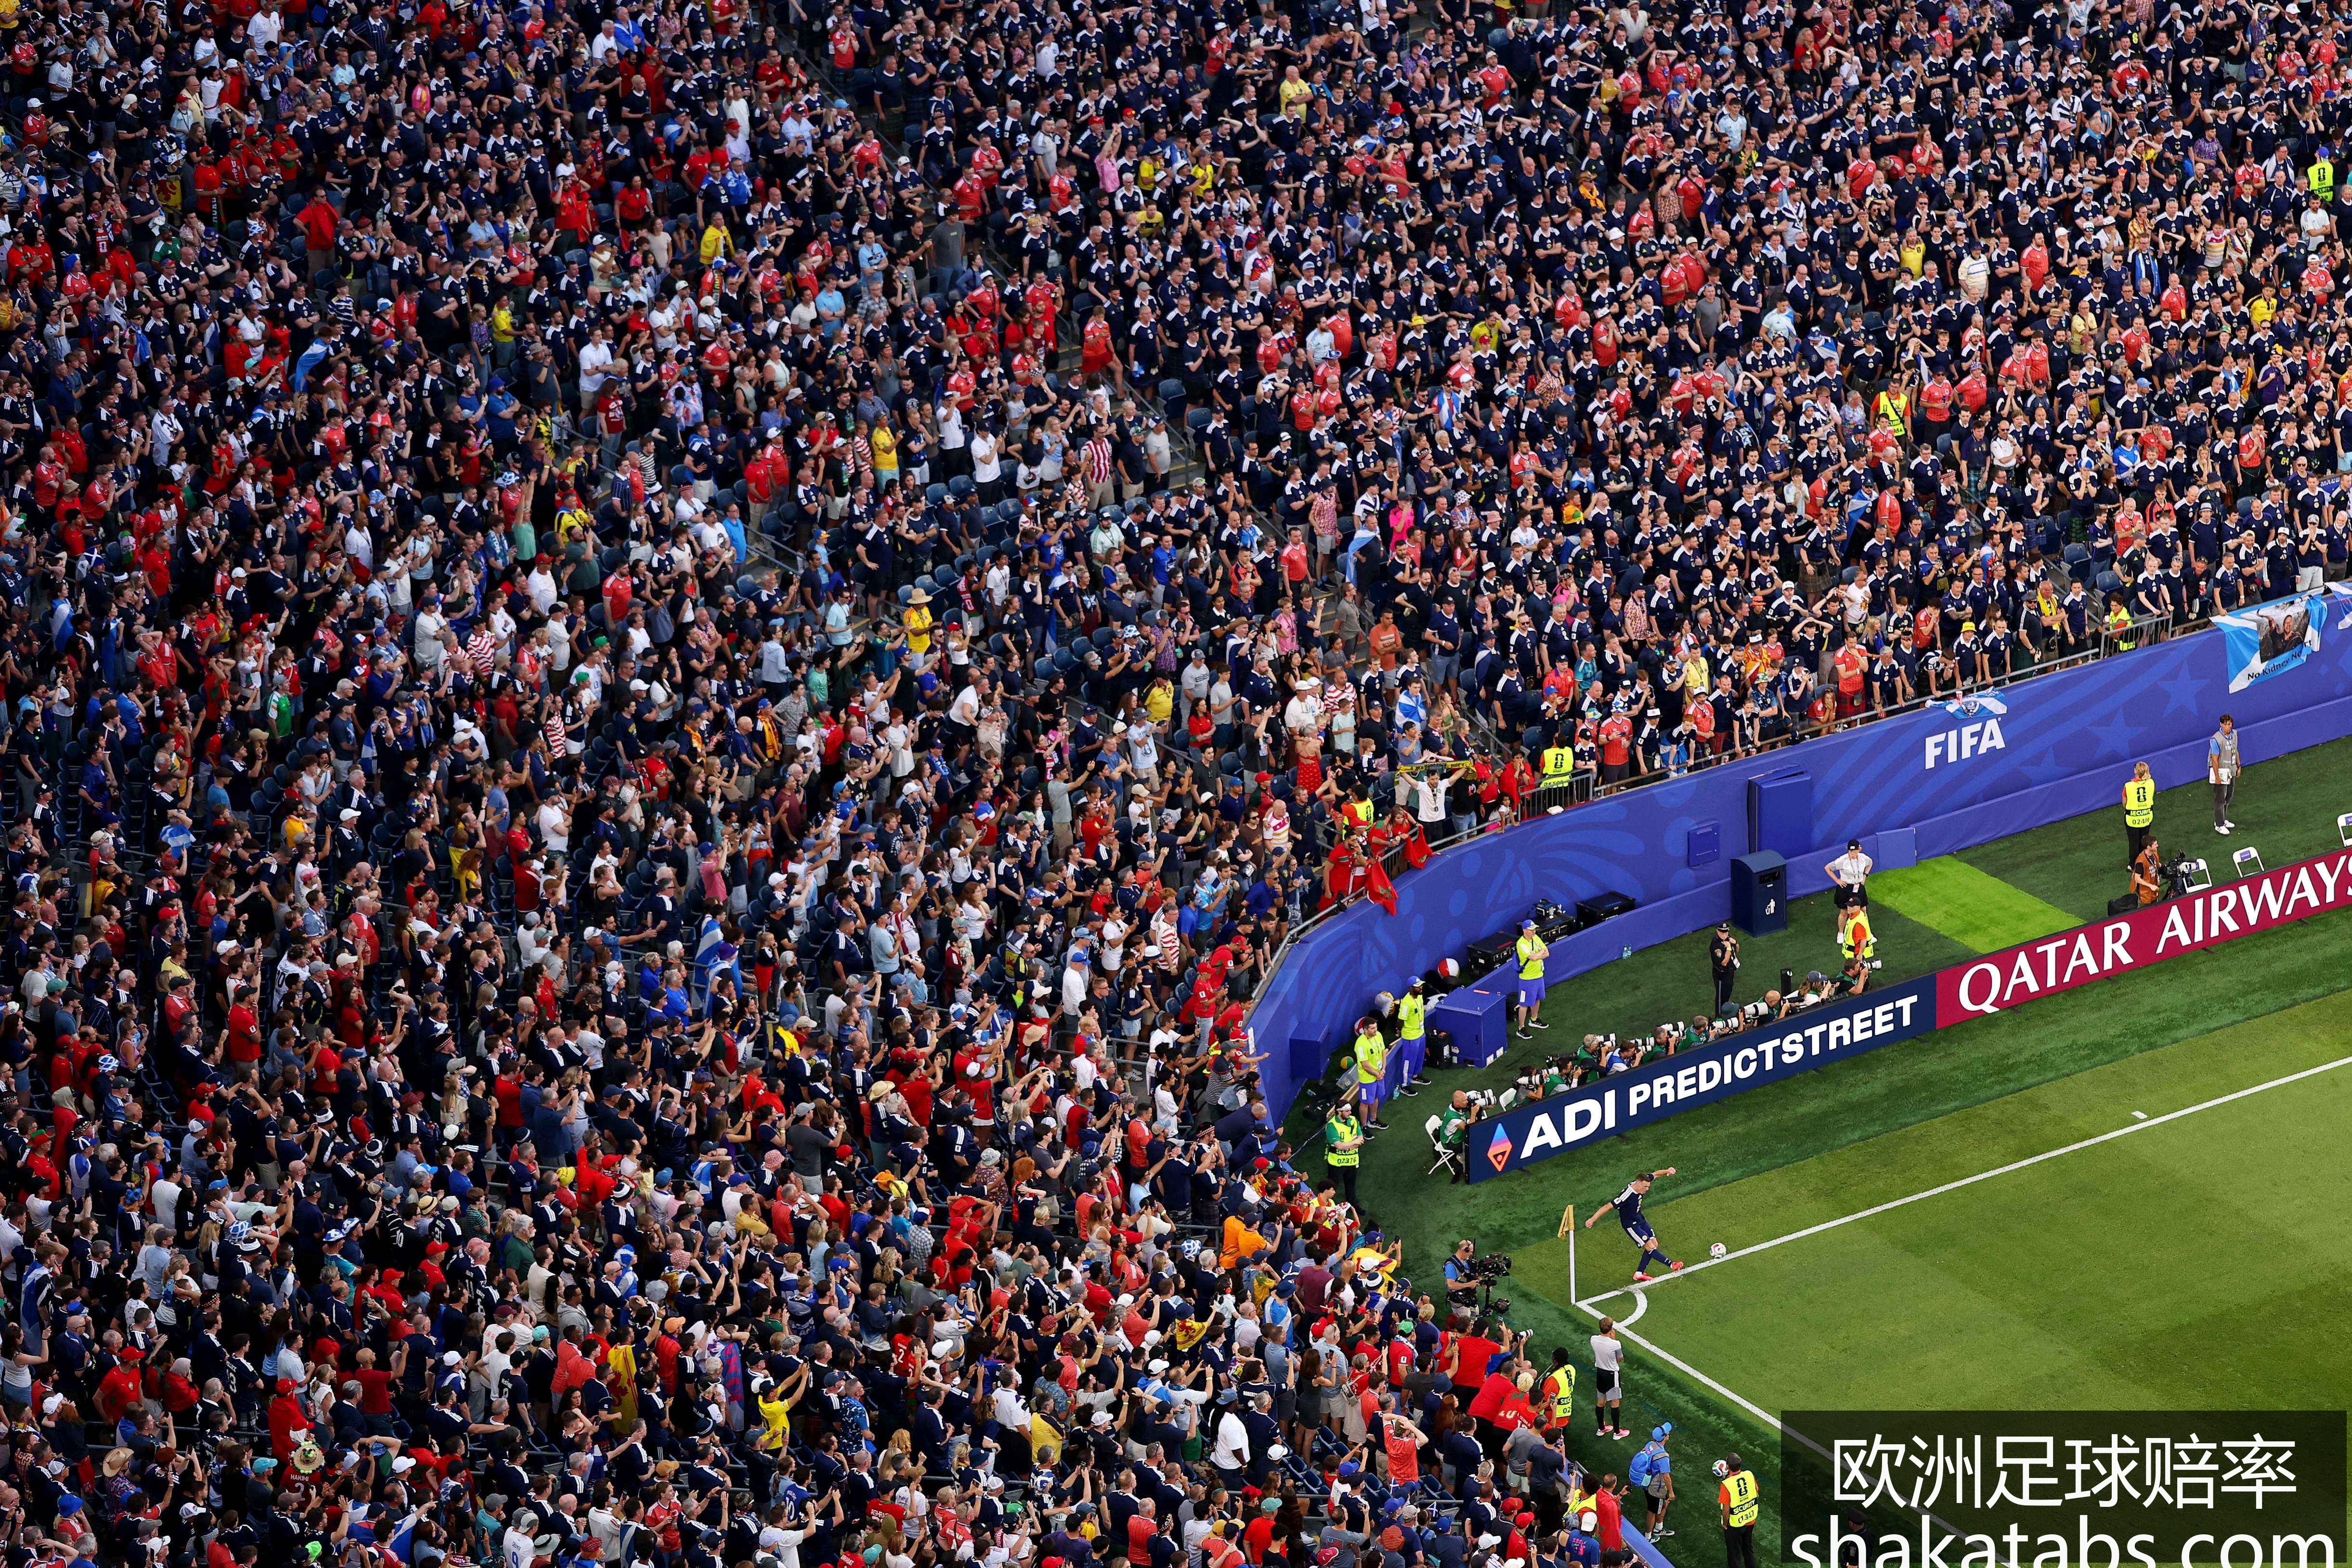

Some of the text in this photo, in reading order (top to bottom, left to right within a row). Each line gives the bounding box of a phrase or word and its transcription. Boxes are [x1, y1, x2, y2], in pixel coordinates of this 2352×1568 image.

[2262, 658, 2289, 676] Kidney
[1925, 718, 2005, 769] FIFA
[1959, 921, 2134, 1013] QATAR
[1520, 995, 1918, 1159] ADI PREDICTSTREET
[897, 1349, 904, 1363] 2
[294, 1482, 306, 1501] 2
[1733, 1499, 1755, 1515] SECURITY
